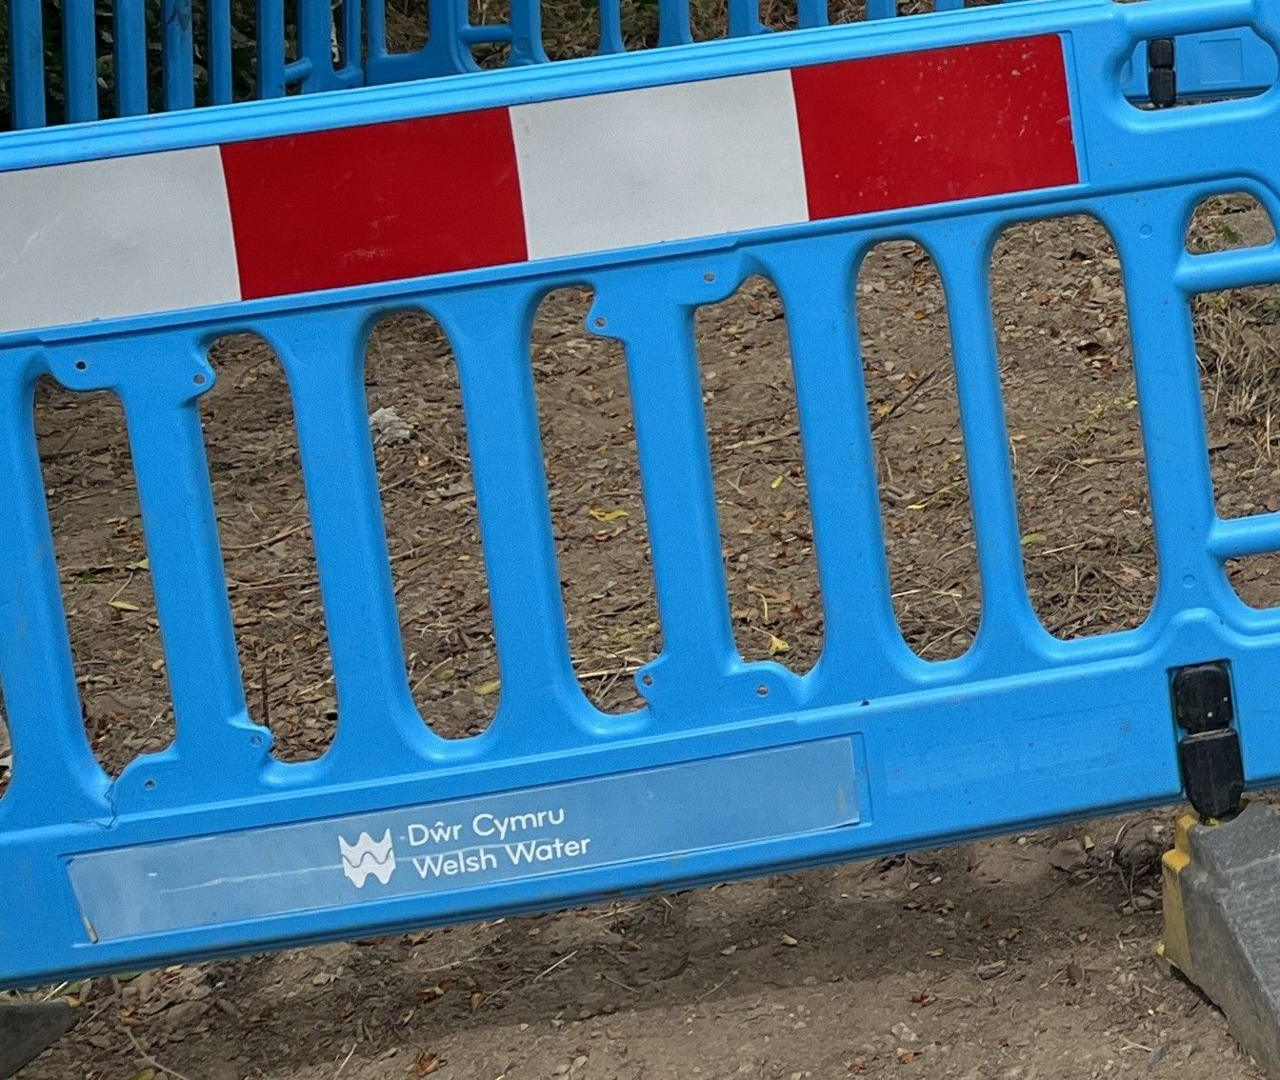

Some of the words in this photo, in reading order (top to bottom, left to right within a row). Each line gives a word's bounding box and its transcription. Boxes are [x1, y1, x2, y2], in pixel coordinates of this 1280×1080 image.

[407, 821, 463, 847] Dŵr
[472, 808, 565, 841] Cymru
[412, 848, 498, 879] Welsh
[504, 838, 591, 866] Water
